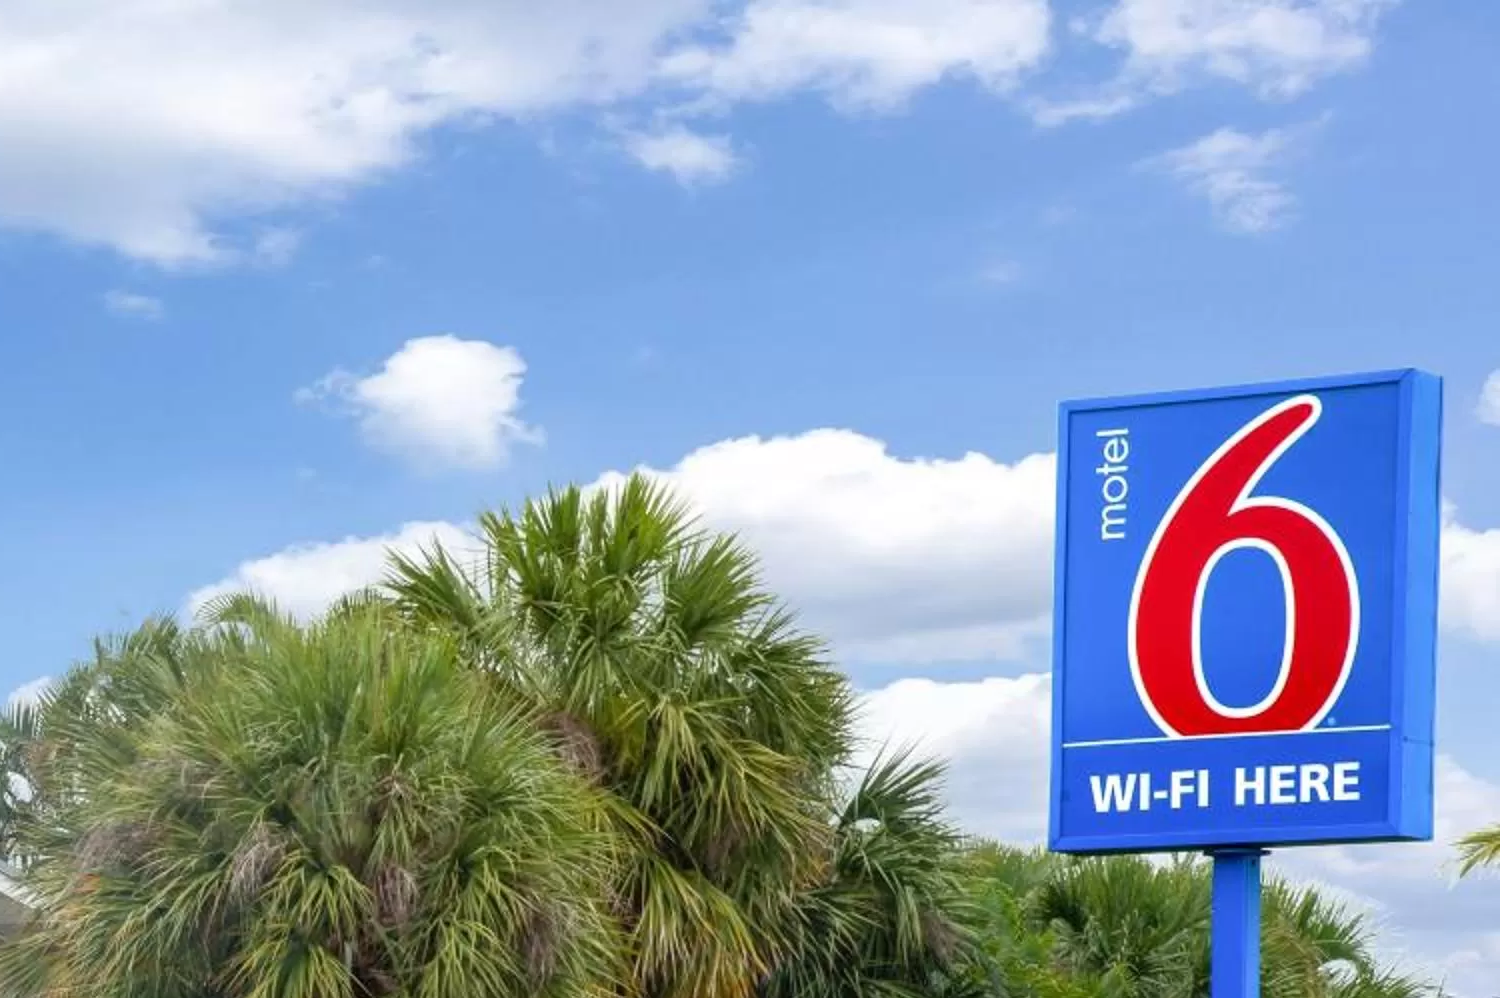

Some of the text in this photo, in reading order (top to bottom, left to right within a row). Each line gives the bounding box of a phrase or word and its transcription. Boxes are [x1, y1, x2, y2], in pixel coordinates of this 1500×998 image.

[1095, 428, 1130, 540] motel
[1127, 393, 1361, 739] 6
[1089, 761, 1361, 814] WI-FI HERE
